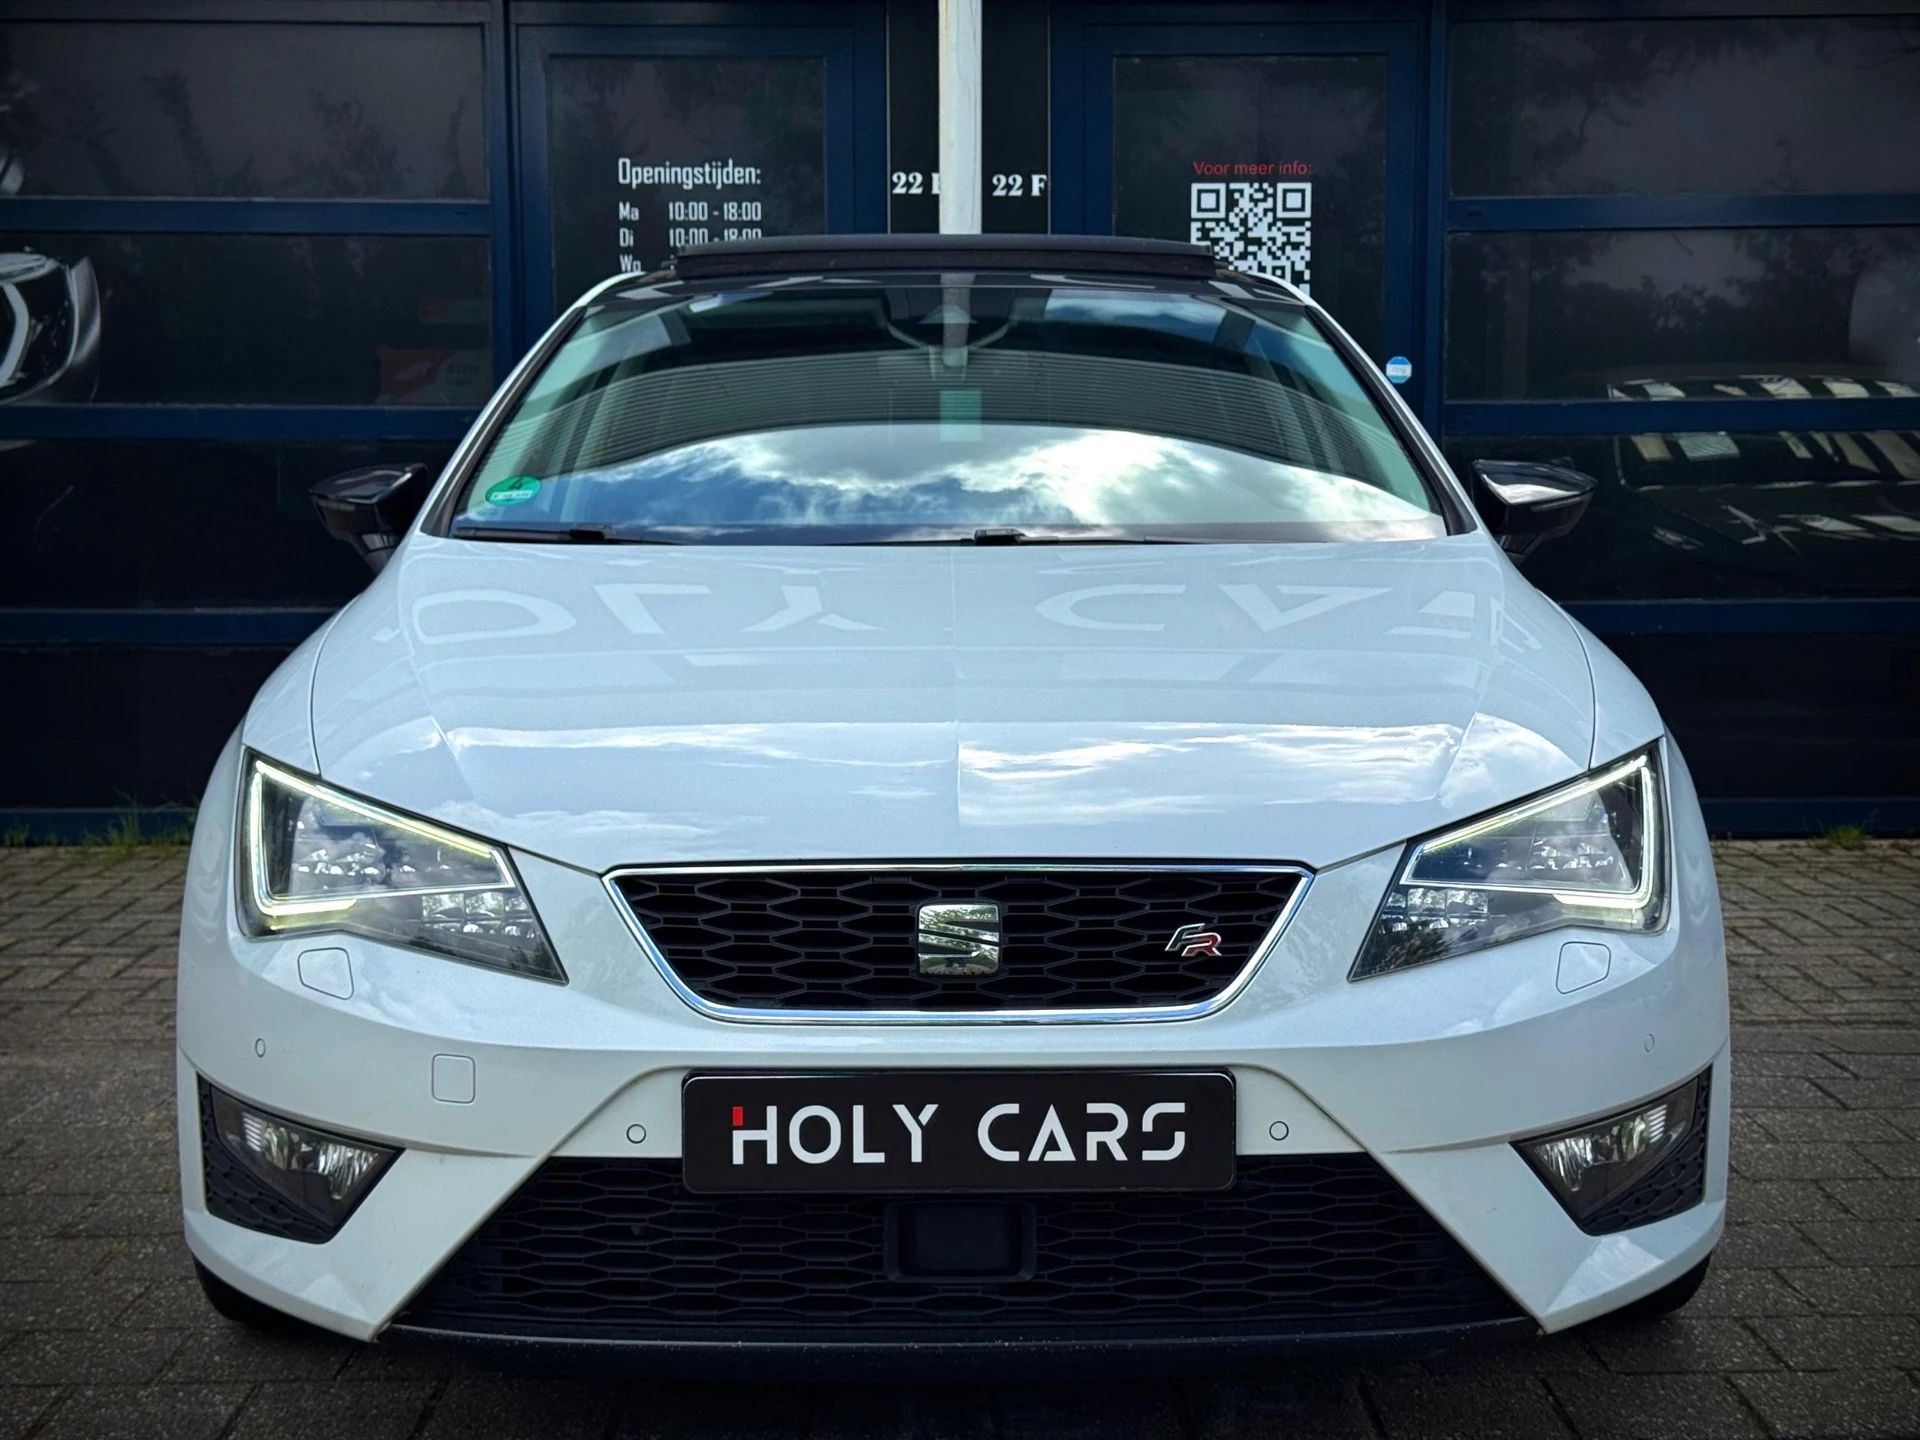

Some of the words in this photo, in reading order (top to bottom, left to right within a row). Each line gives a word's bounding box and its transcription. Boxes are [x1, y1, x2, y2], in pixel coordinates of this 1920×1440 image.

[618, 157, 761, 190] Openingstijden:
[1193, 161, 1229, 175] Voor
[1234, 162, 1274, 175] meer
[1279, 160, 1312, 175] info:
[892, 171, 923, 195] 22
[992, 174, 1023, 197] 22
[1031, 174, 1048, 197] F
[618, 201, 640, 222] Ma
[669, 201, 708, 222] 10:00
[724, 201, 762, 222] 18:00
[619, 227, 635, 248] Di
[669, 227, 709, 248] 10:00
[619, 254, 642, 273] Wo
[1164, 922, 1222, 957] FR
[732, 1104, 938, 1165] HOLY
[977, 1102, 1186, 1162] CARS
